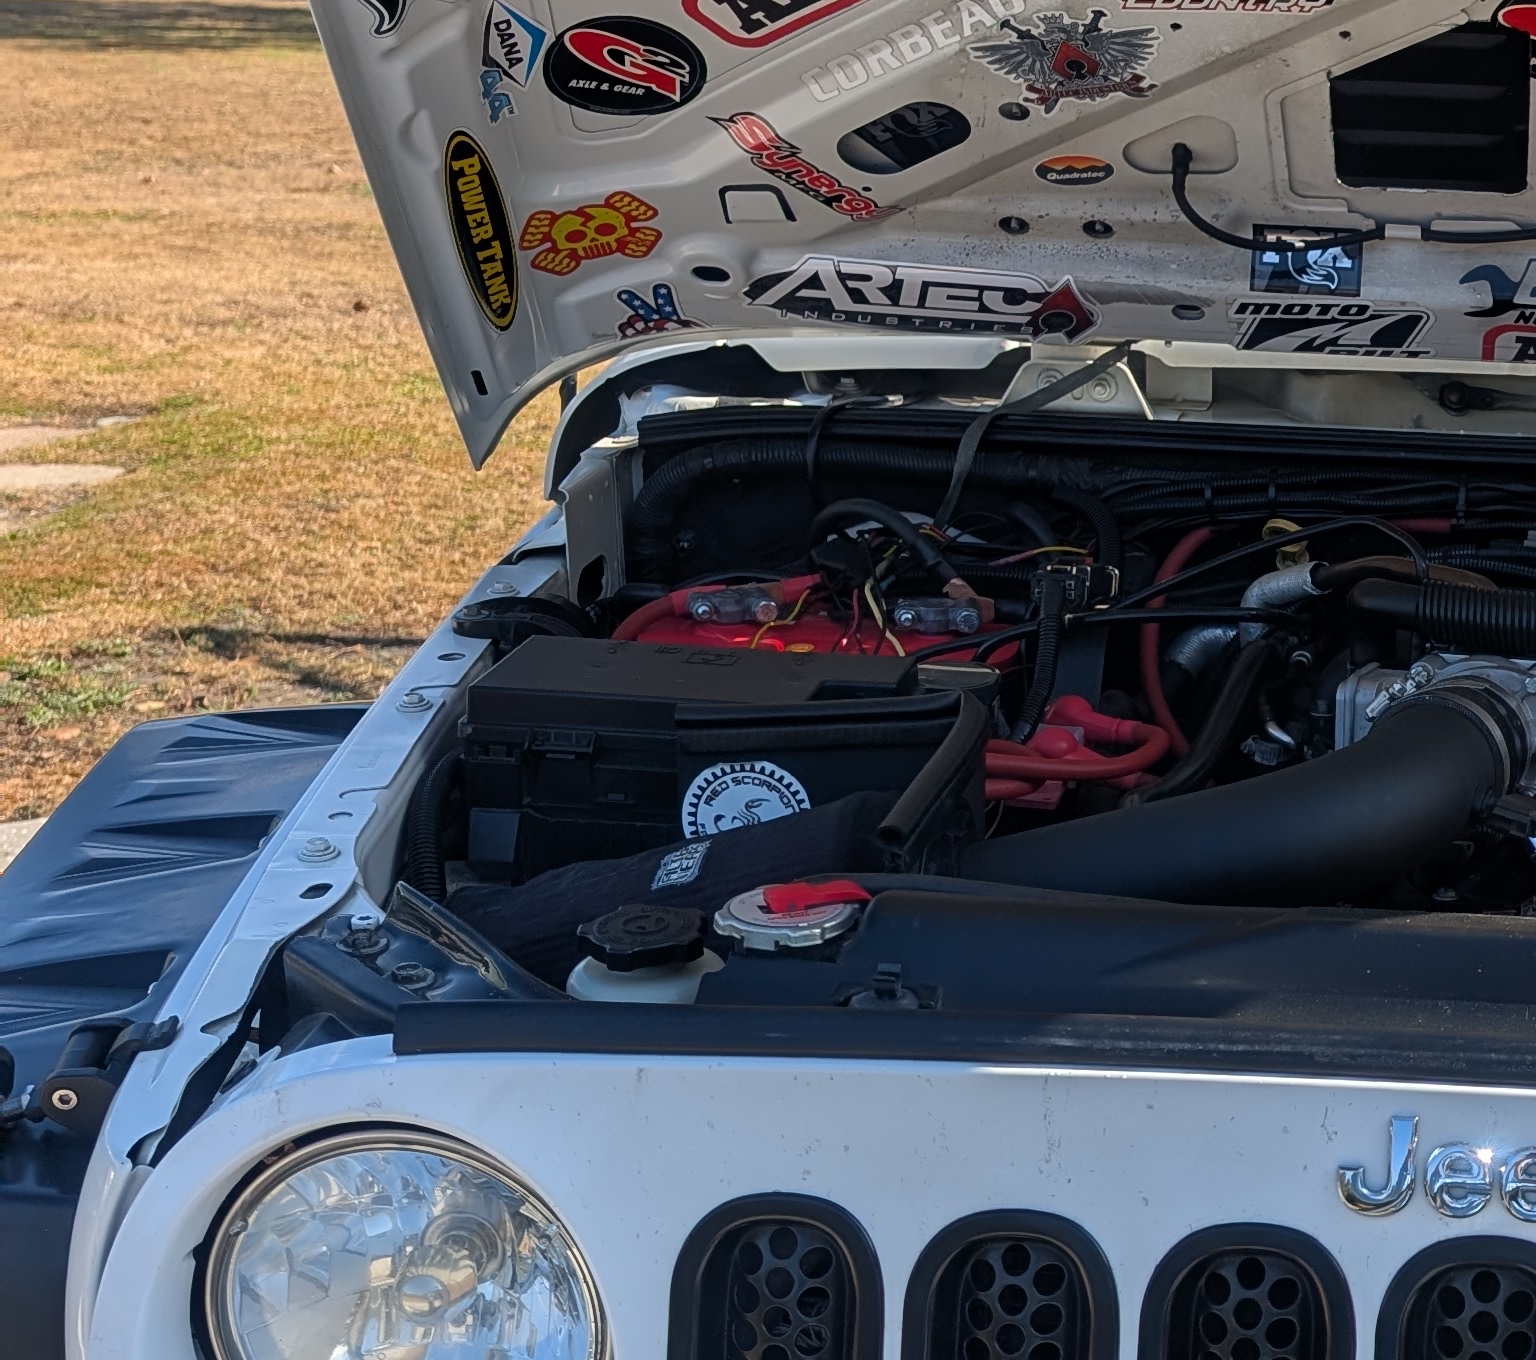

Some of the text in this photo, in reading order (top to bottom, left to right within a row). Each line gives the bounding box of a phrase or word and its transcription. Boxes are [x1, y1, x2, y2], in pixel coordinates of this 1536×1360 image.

[493, 18, 524, 71] DANA
[563, 28, 690, 102] G2
[568, 78, 646, 96] AXLE & GEAR
[451, 154, 512, 309] POWER TANK
[751, 259, 1046, 324] ARTEC
[1234, 302, 1371, 316] MOTO
[779, 309, 1035, 336] INDUSTRIES
[703, 780, 731, 807] RED
